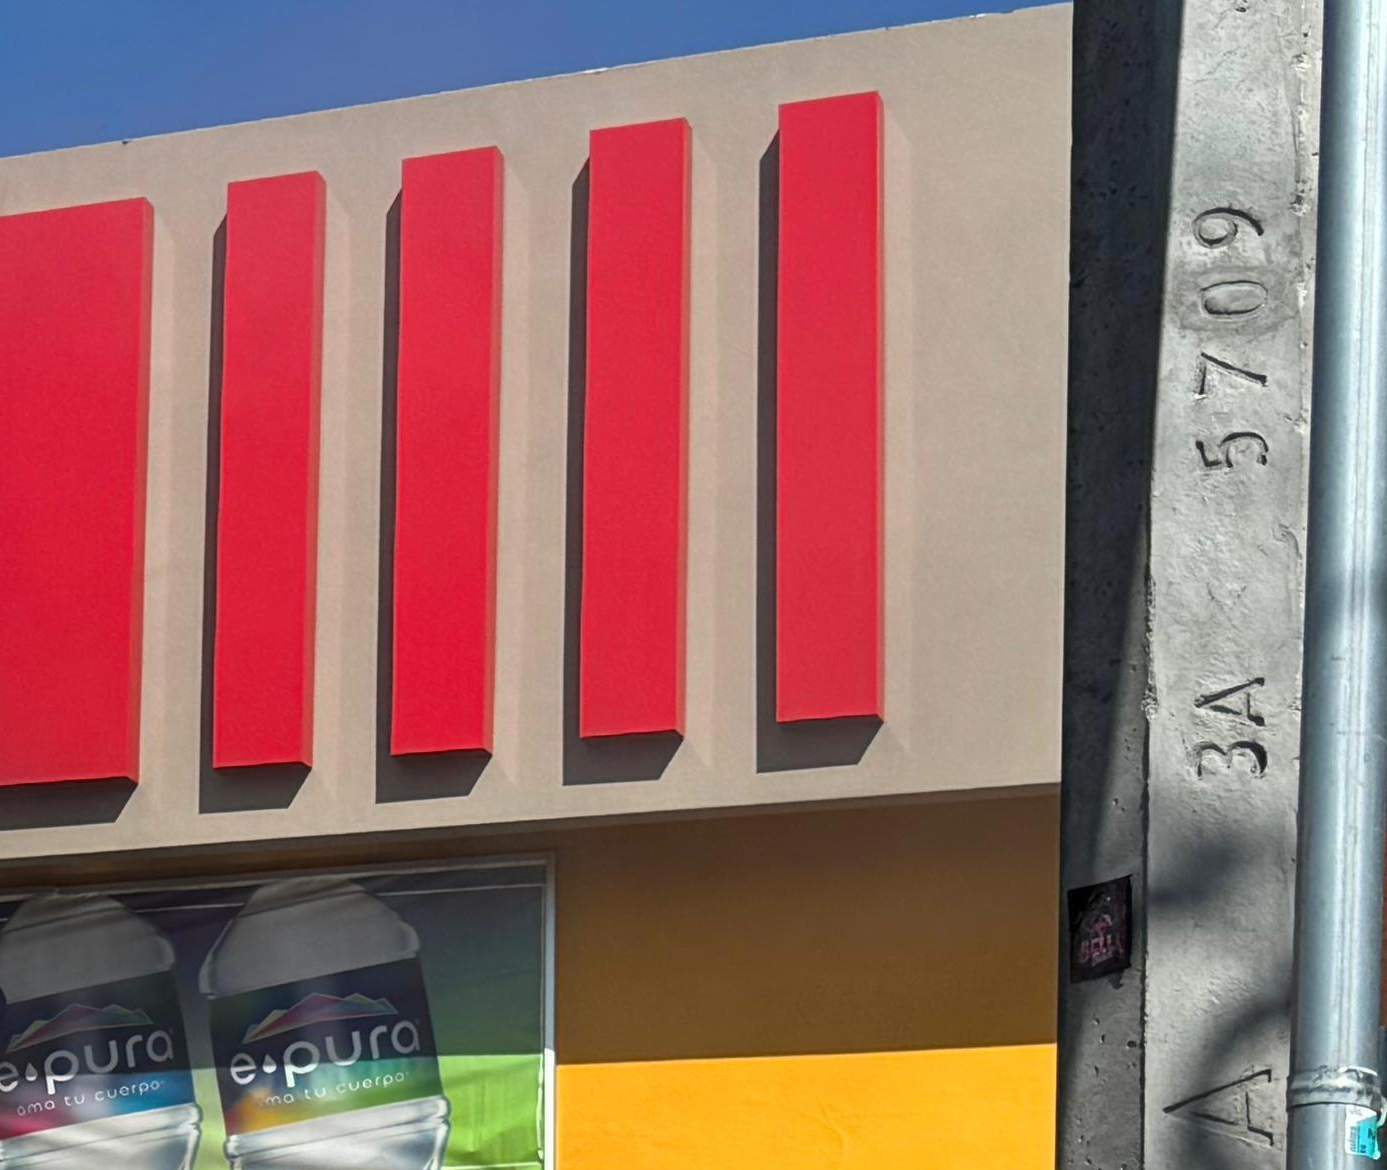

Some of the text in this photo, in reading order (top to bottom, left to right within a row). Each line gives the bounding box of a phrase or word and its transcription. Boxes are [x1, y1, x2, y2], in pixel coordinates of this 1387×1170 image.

[17, 1079, 161, 1116] ama tu cuerpo
[304, 1087, 327, 1101] tu
[335, 1072, 405, 1096] cuerpo
